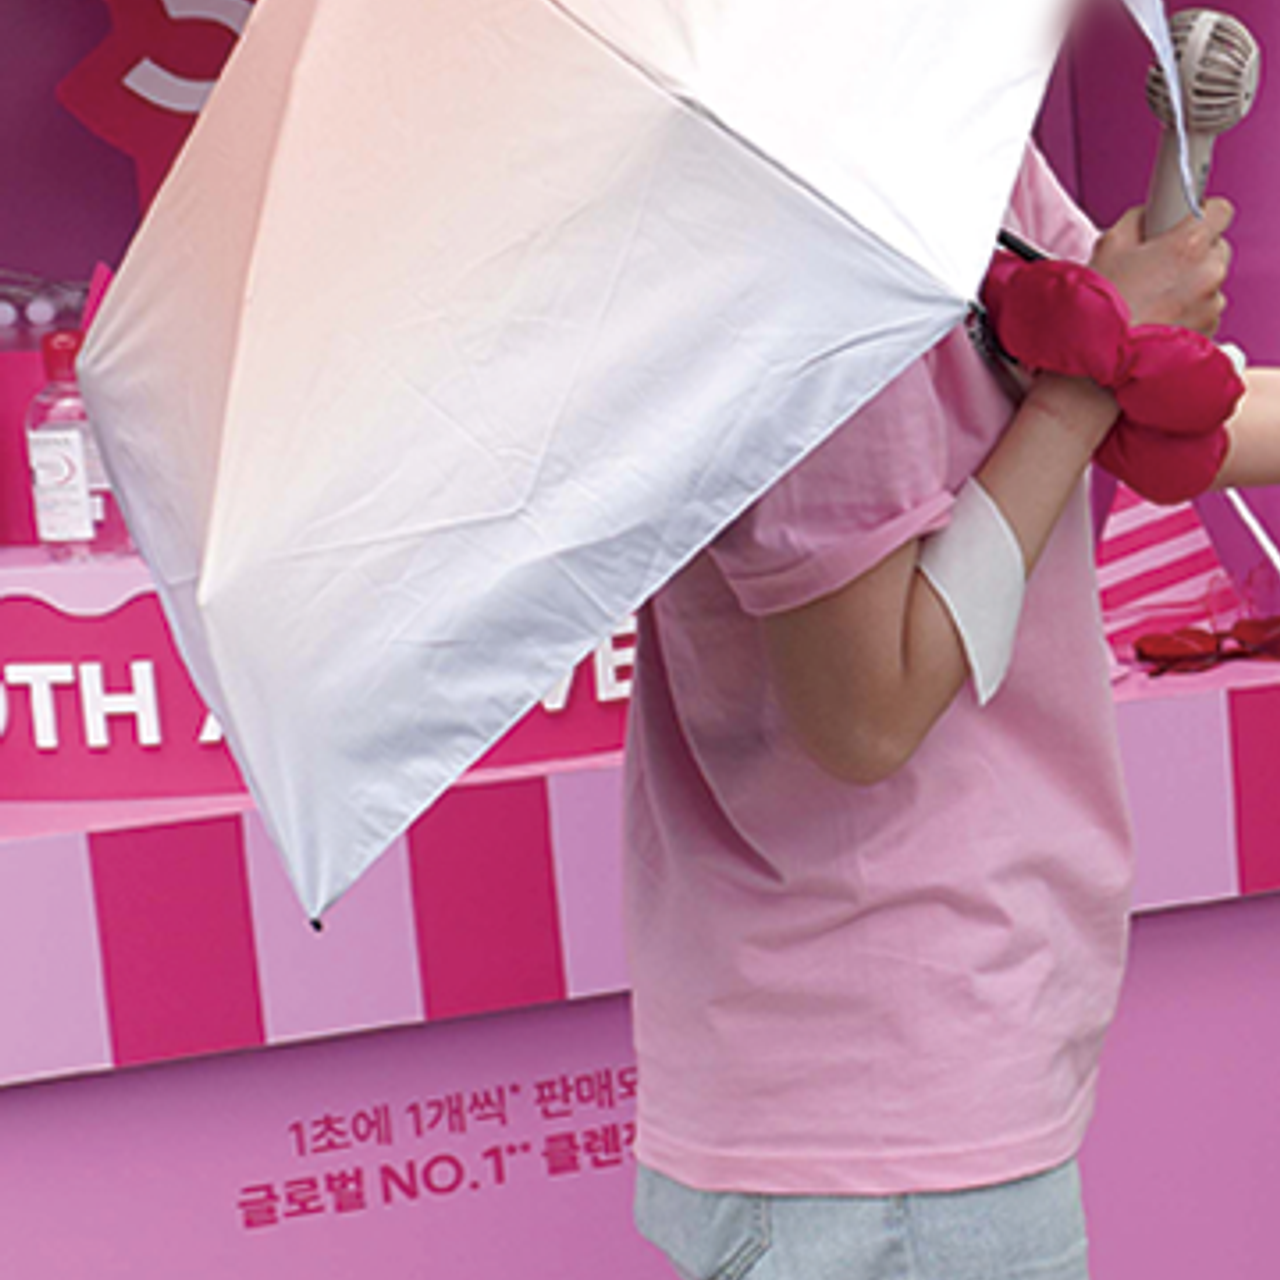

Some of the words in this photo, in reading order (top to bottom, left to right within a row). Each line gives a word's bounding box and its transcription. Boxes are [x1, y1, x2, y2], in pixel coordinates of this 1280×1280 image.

[0, 661, 162, 748] TH
[288, 1103, 393, 1157] 1초에
[237, 1166, 367, 1229] 글로벌
